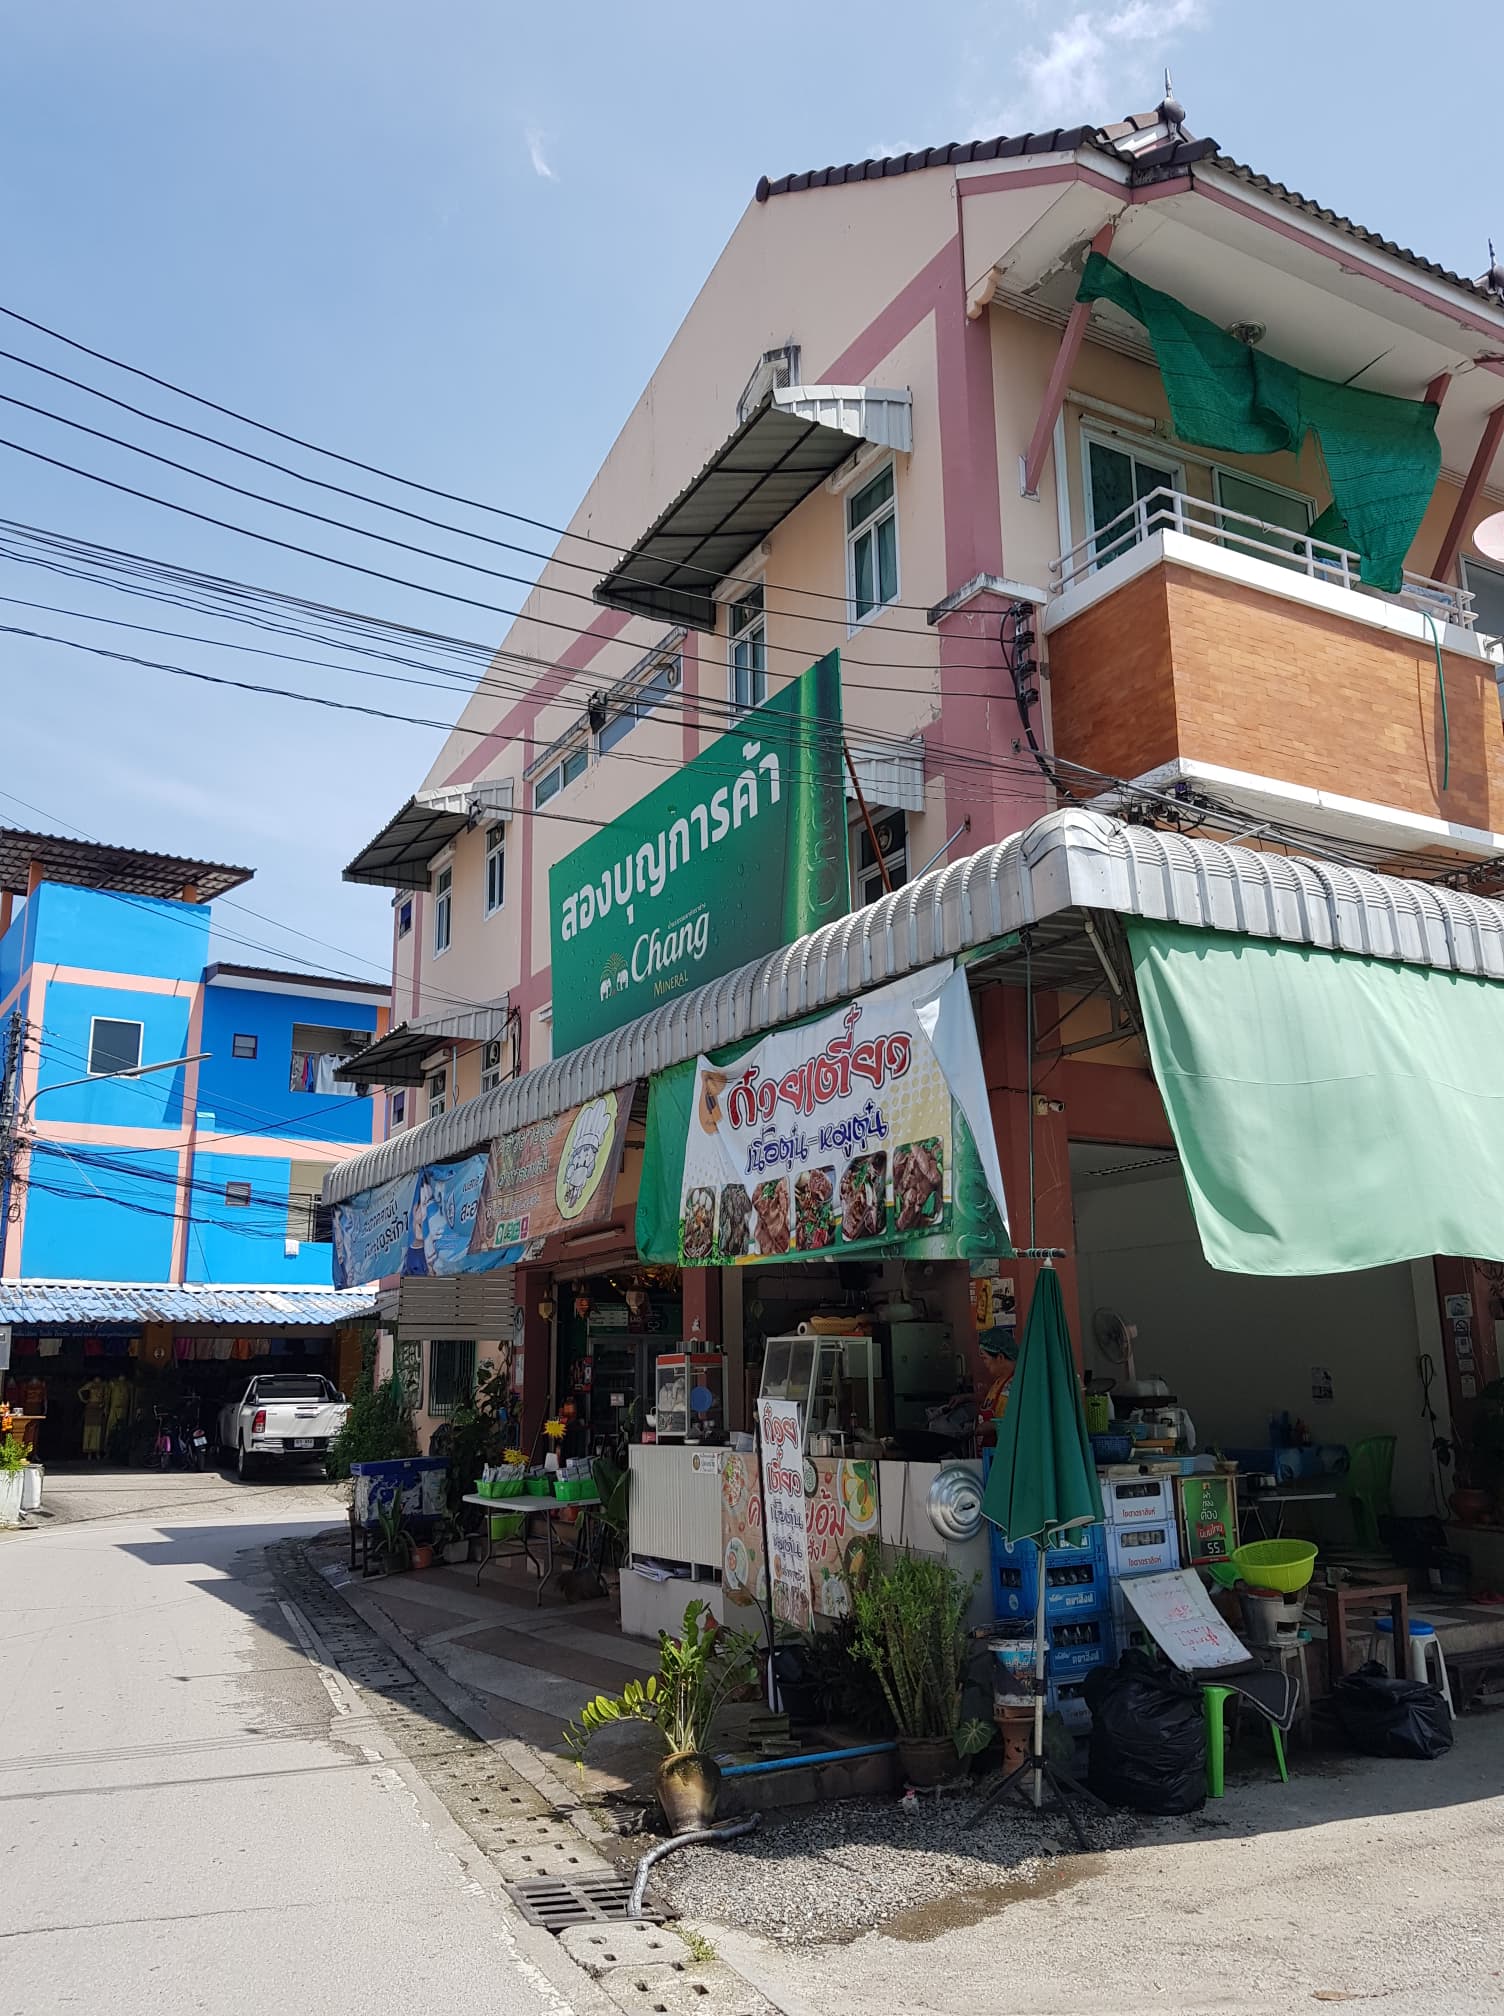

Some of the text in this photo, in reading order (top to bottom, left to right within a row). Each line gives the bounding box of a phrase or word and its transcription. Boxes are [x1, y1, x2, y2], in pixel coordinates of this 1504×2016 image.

[561, 741, 781, 941] สองบุญการค้า
[631, 911, 710, 983] Chang
[654, 970, 689, 998] MINERAL
